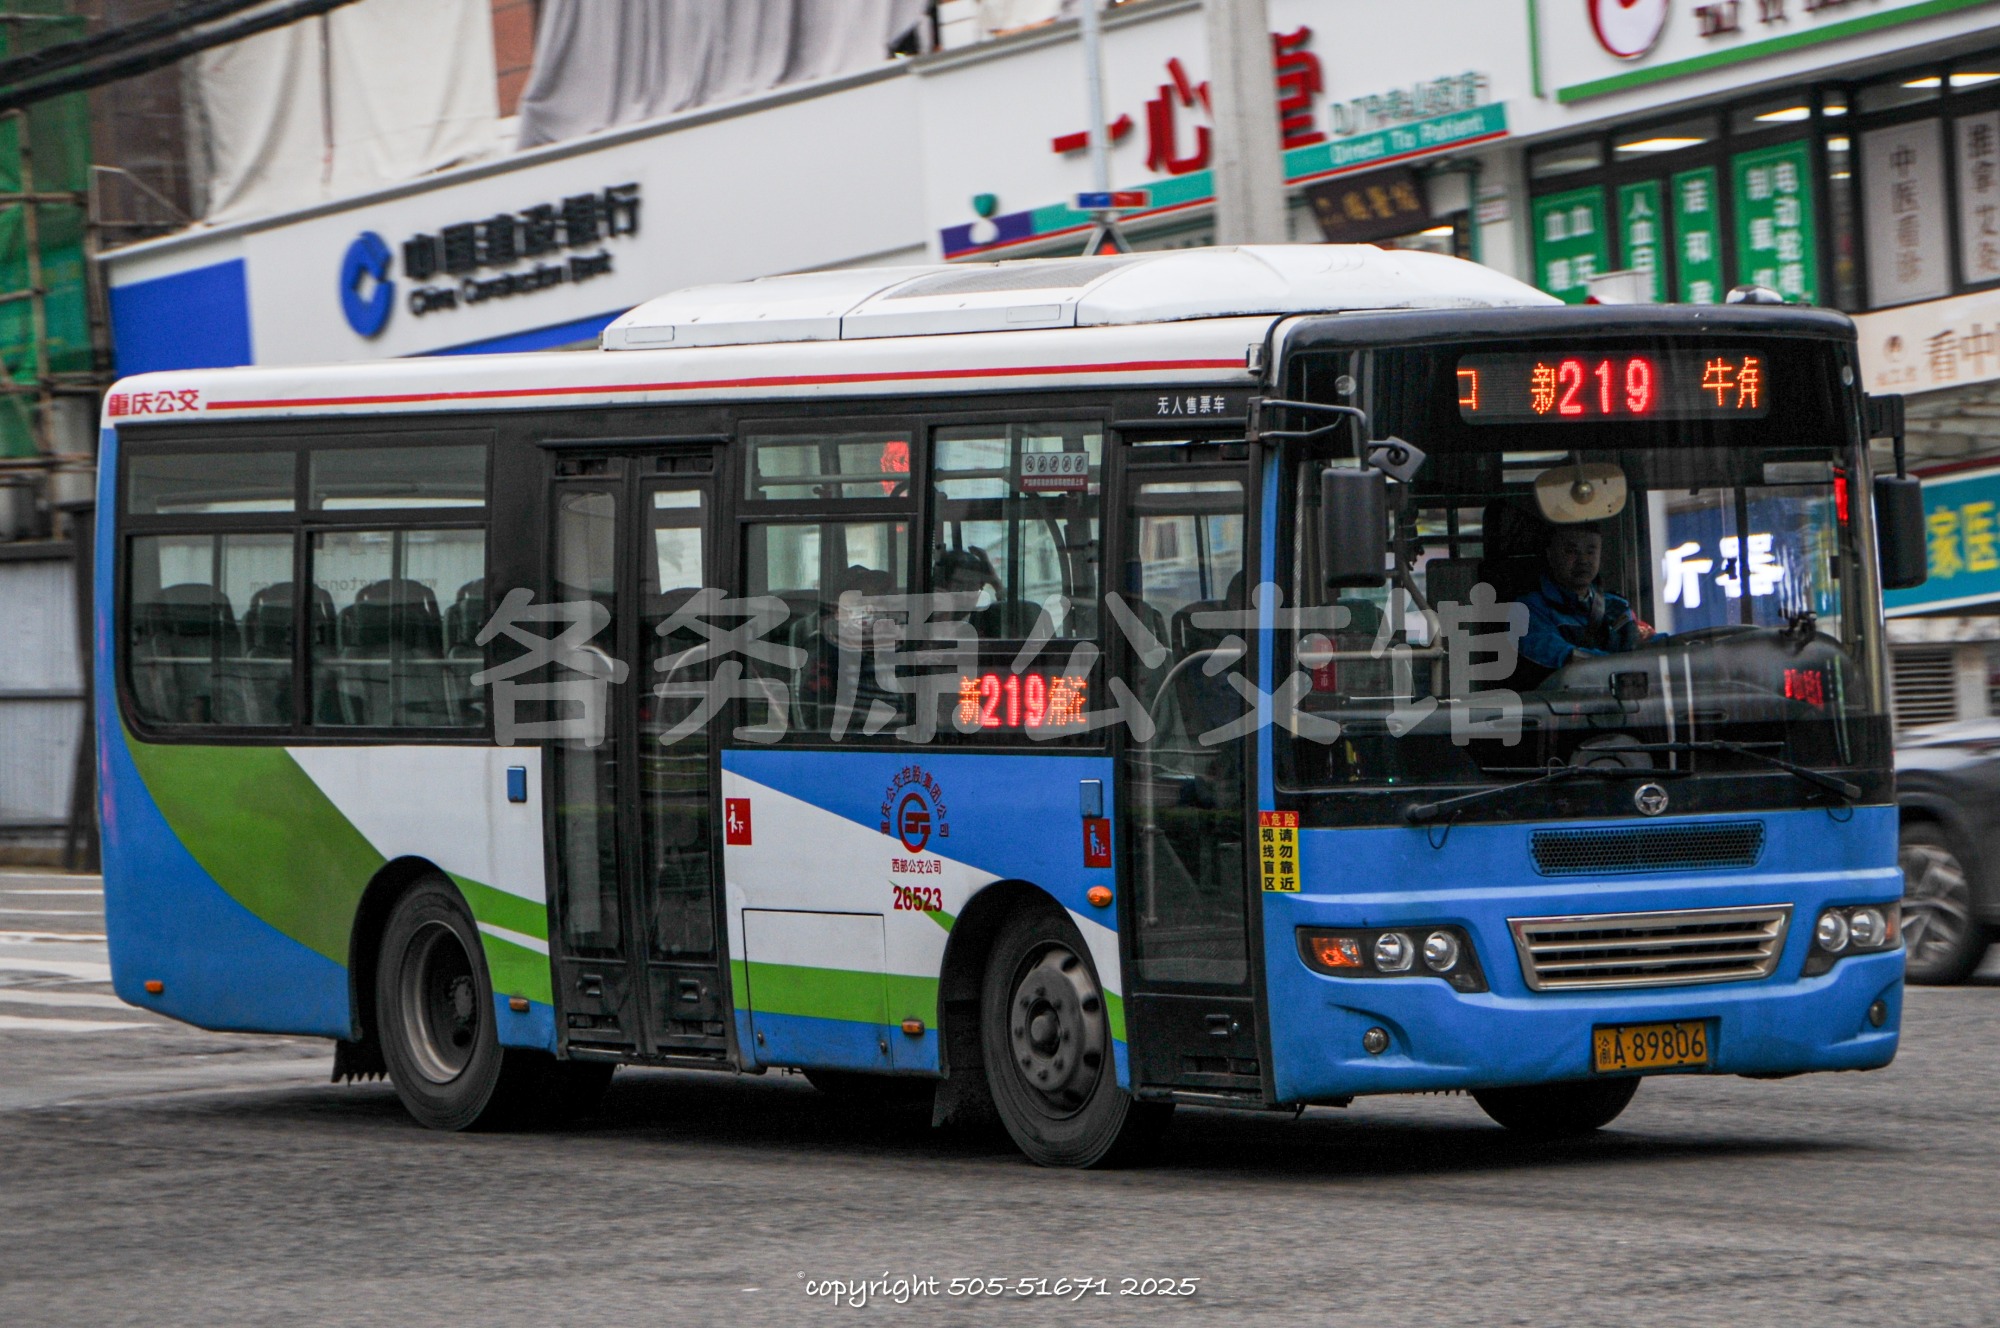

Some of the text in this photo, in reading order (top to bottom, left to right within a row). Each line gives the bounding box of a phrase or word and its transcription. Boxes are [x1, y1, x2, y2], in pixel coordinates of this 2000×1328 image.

[1391, 129, 1417, 151] To
[1419, 115, 1485, 144] Patient
[108, 389, 199, 417] 重庆公交
[1157, 395, 1225, 415] 无人售票车
[736, 820, 744, 834] 下
[1271, 813, 1296, 827] 危险
[891, 858, 942, 875] 西部公交公司
[1262, 828, 1275, 891] 视线盲区
[1279, 828, 1295, 891] 请勿靠近
[893, 886, 943, 912] 26523
